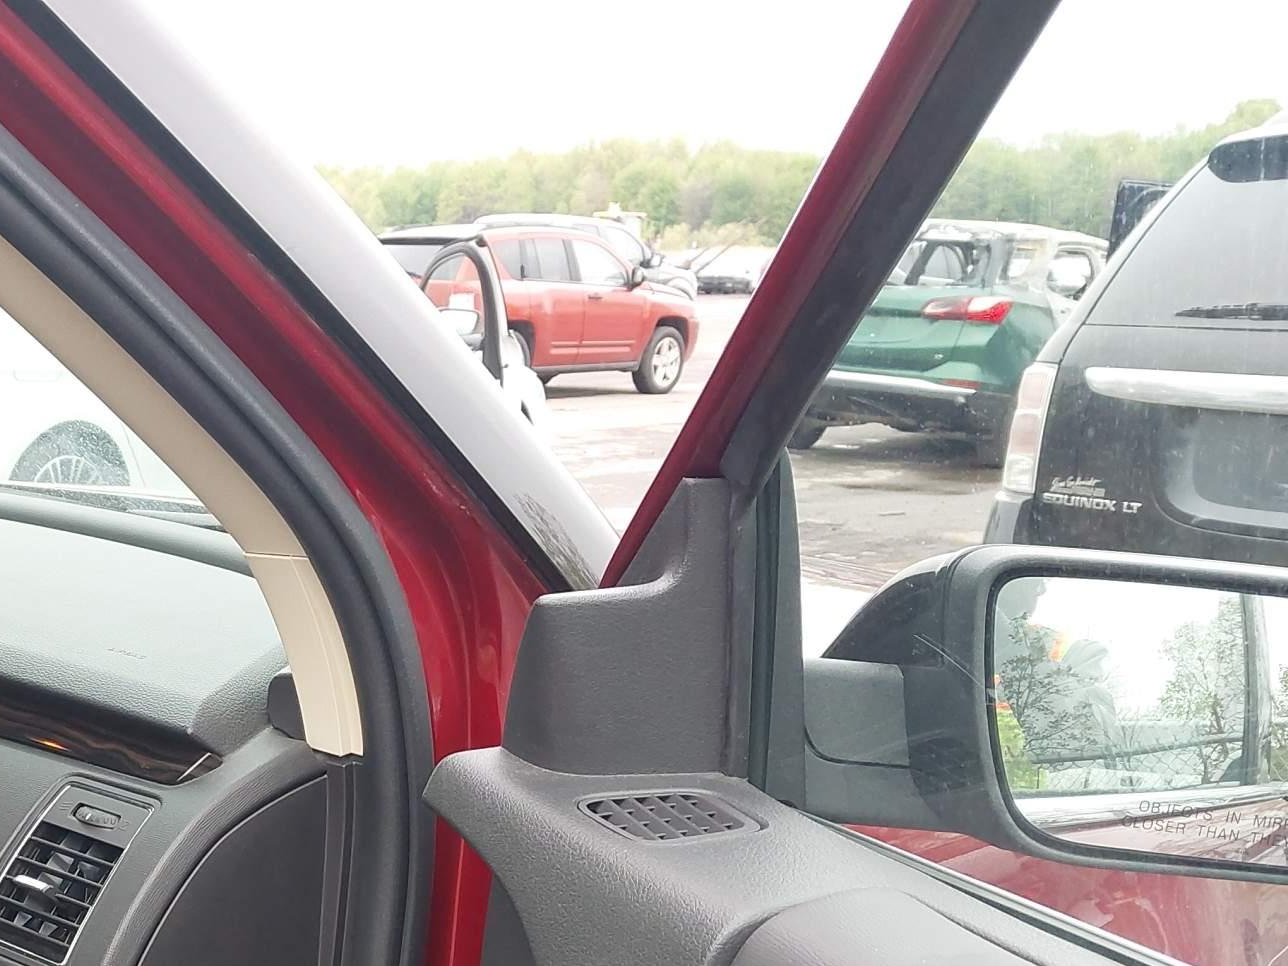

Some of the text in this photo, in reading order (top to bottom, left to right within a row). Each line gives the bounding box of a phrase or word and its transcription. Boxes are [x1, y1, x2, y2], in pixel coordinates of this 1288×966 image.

[1121, 501, 1143, 514] LT
[1138, 800, 1213, 821] OBJECTS
[1225, 810, 1242, 824] IN
[1121, 814, 1186, 834] CLOSER
[1197, 824, 1241, 841] THAN
